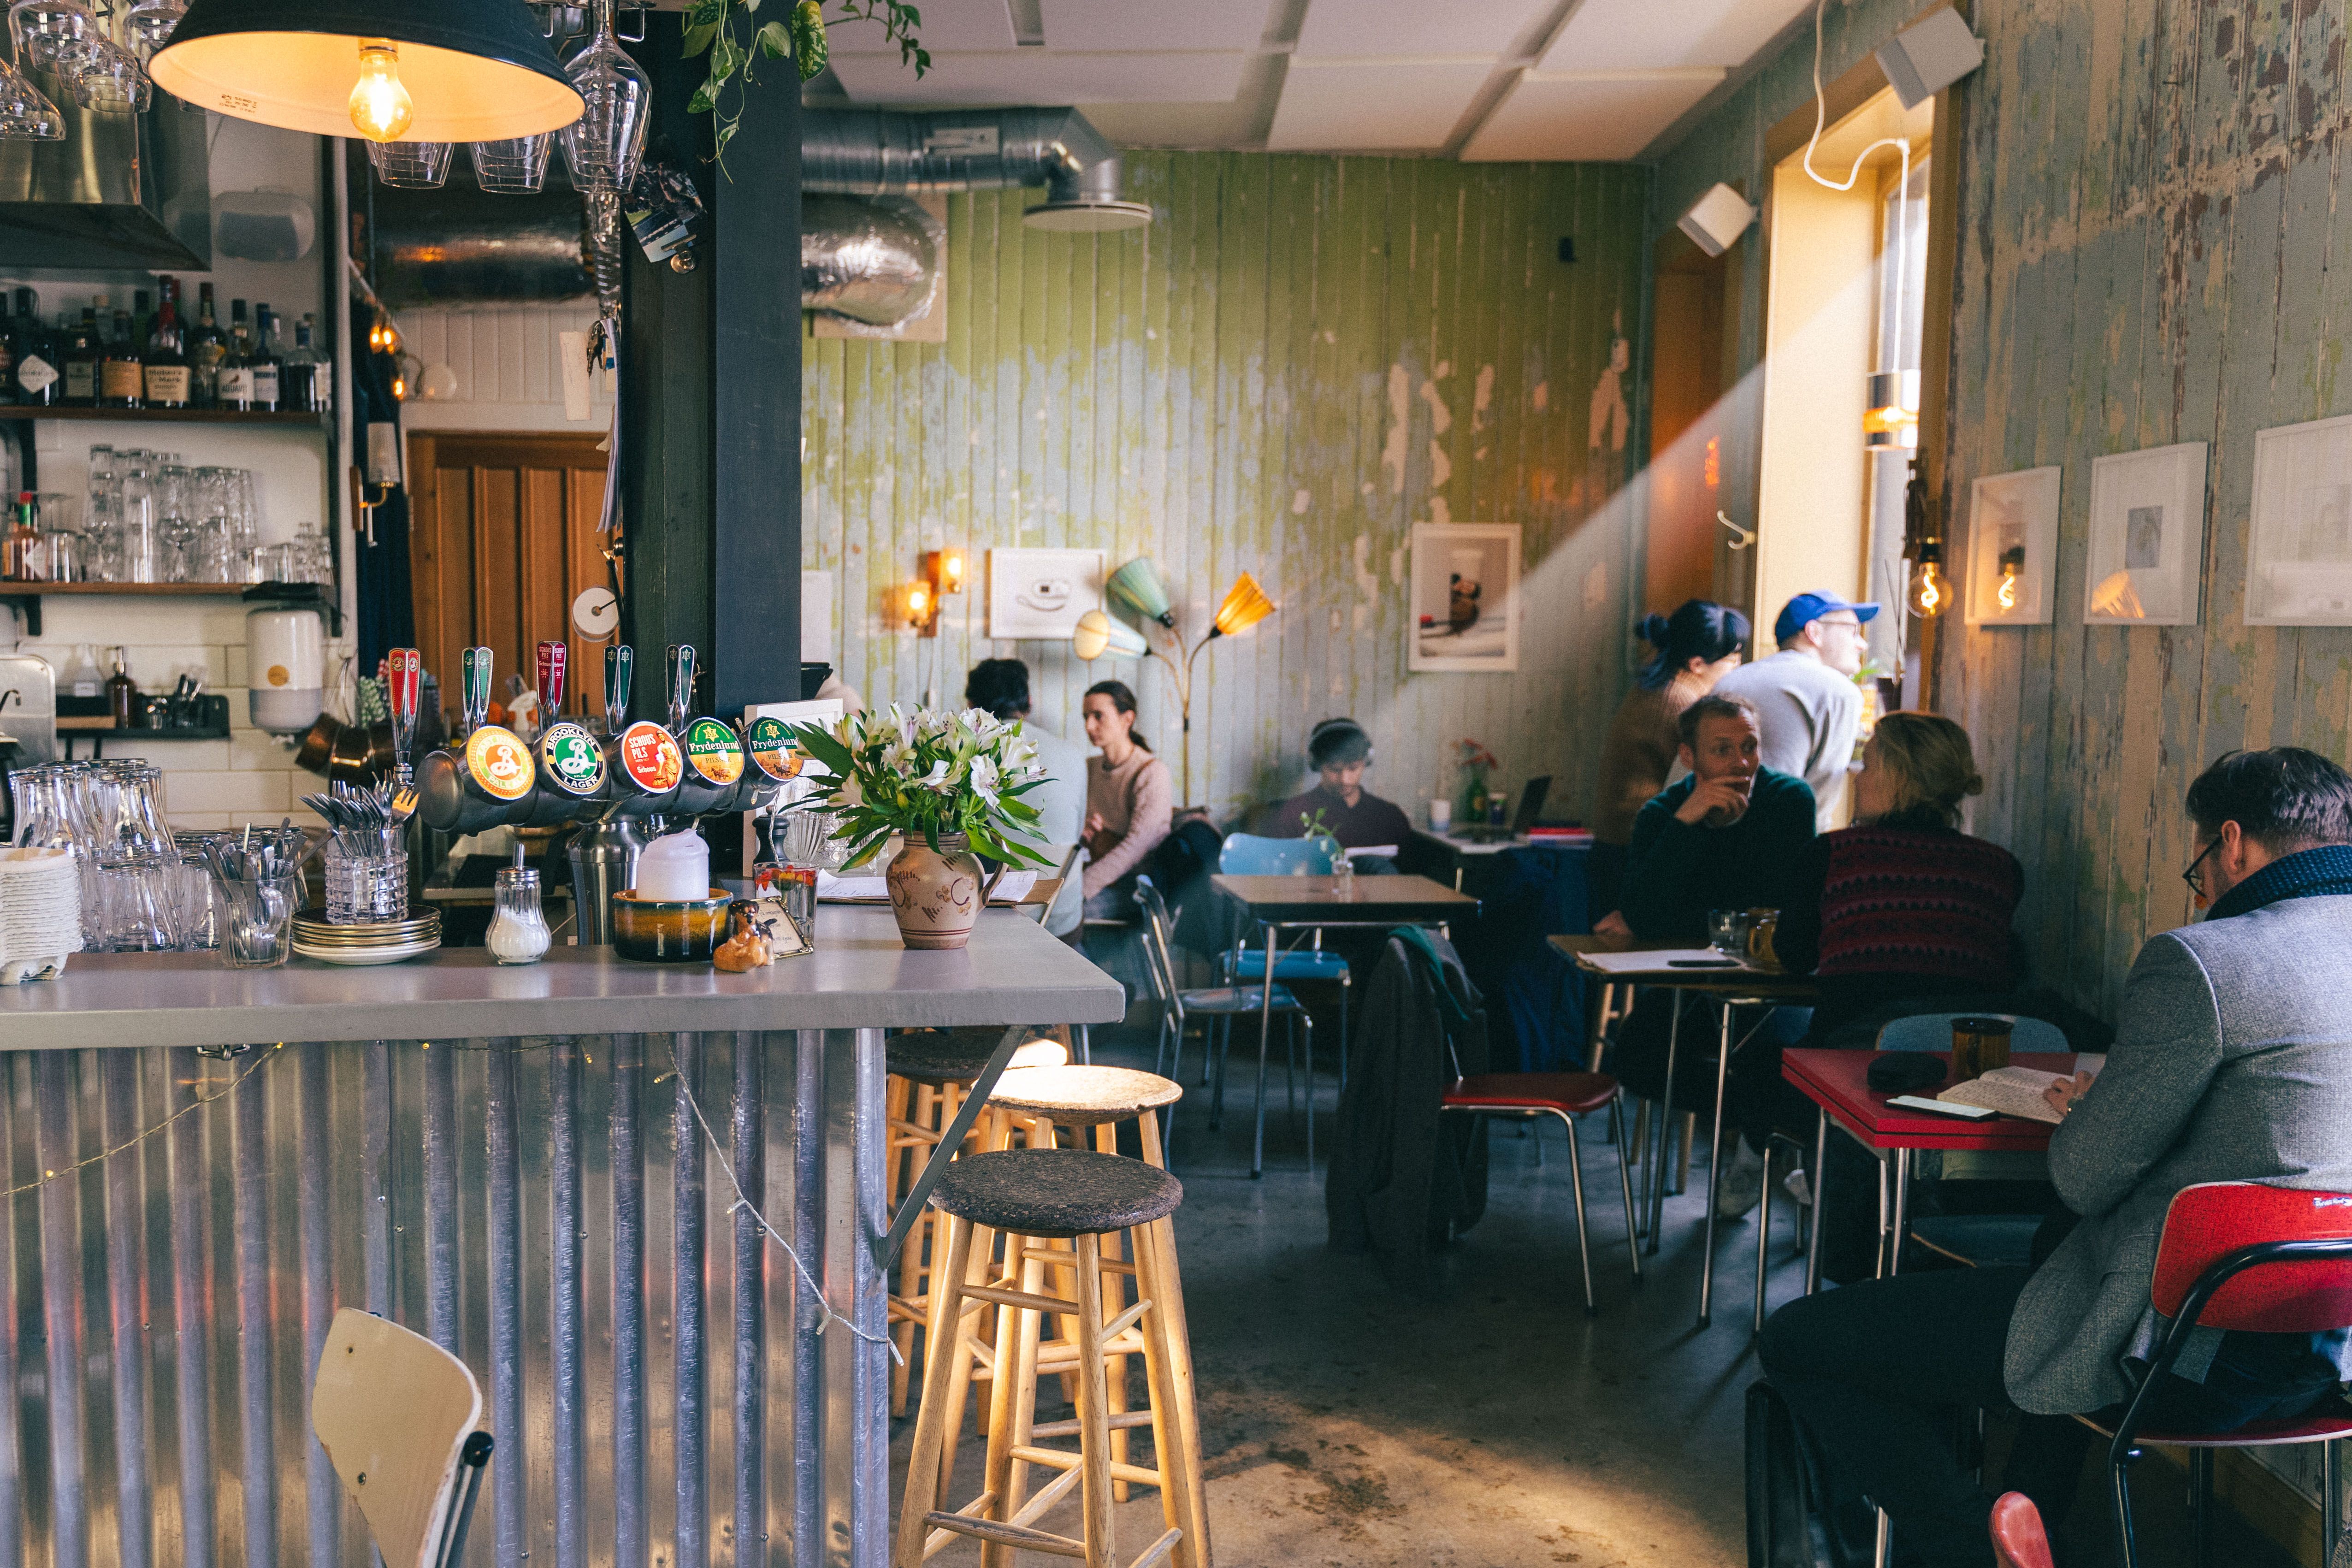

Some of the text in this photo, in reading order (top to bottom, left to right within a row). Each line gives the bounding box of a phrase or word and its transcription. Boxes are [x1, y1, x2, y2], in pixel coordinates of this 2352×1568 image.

[547, 728, 595, 750] BROOKLYN
[628, 734, 656, 749] SCHOUS
[631, 746, 648, 759] PILS
[689, 740, 740, 752] Frydenlund
[563, 775, 598, 788] LAGER
